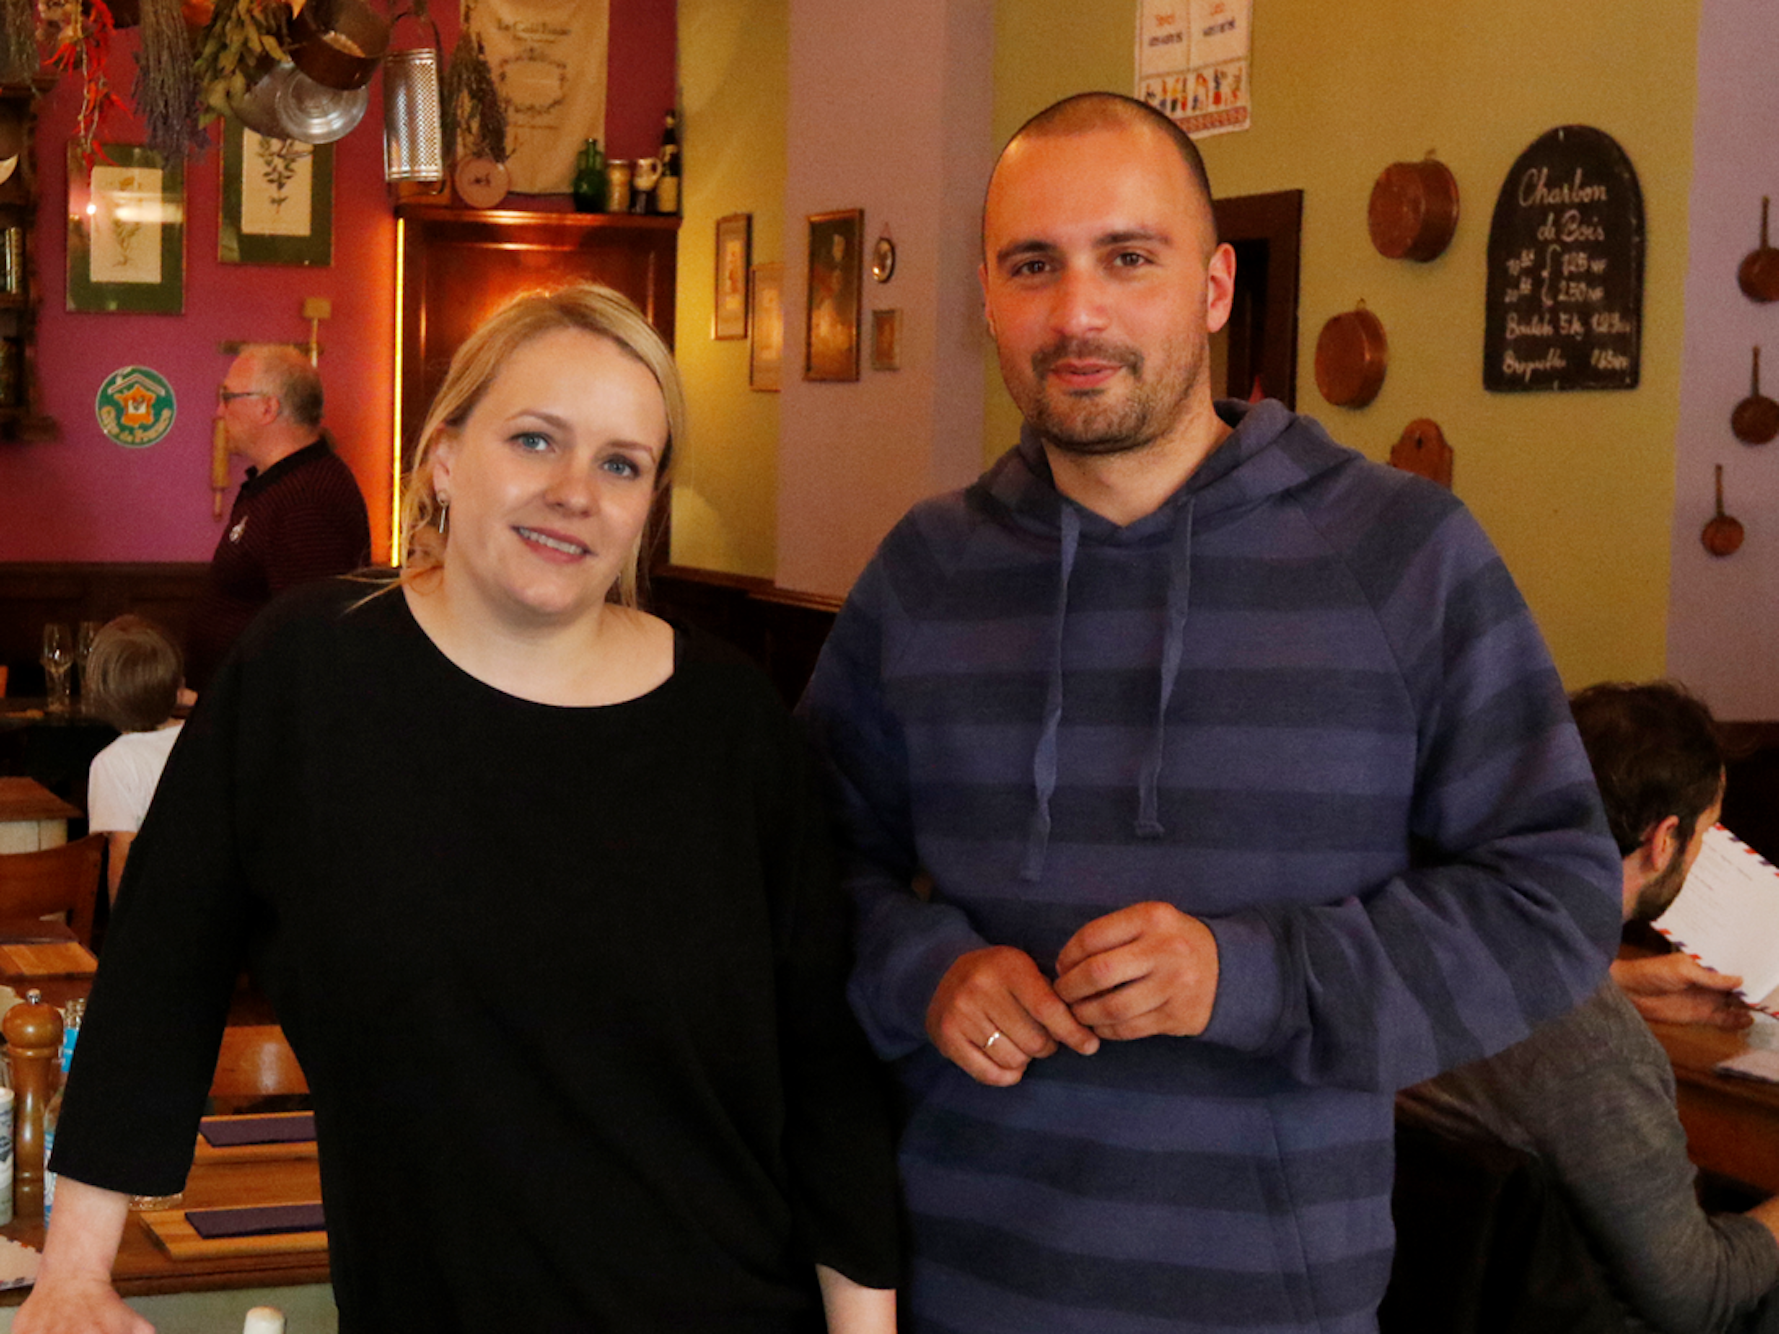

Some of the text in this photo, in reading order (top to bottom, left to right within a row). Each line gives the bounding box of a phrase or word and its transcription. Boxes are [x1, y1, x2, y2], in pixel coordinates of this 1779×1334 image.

[1518, 166, 1608, 207] Charbon
[1537, 208, 1605, 242] de Bois
